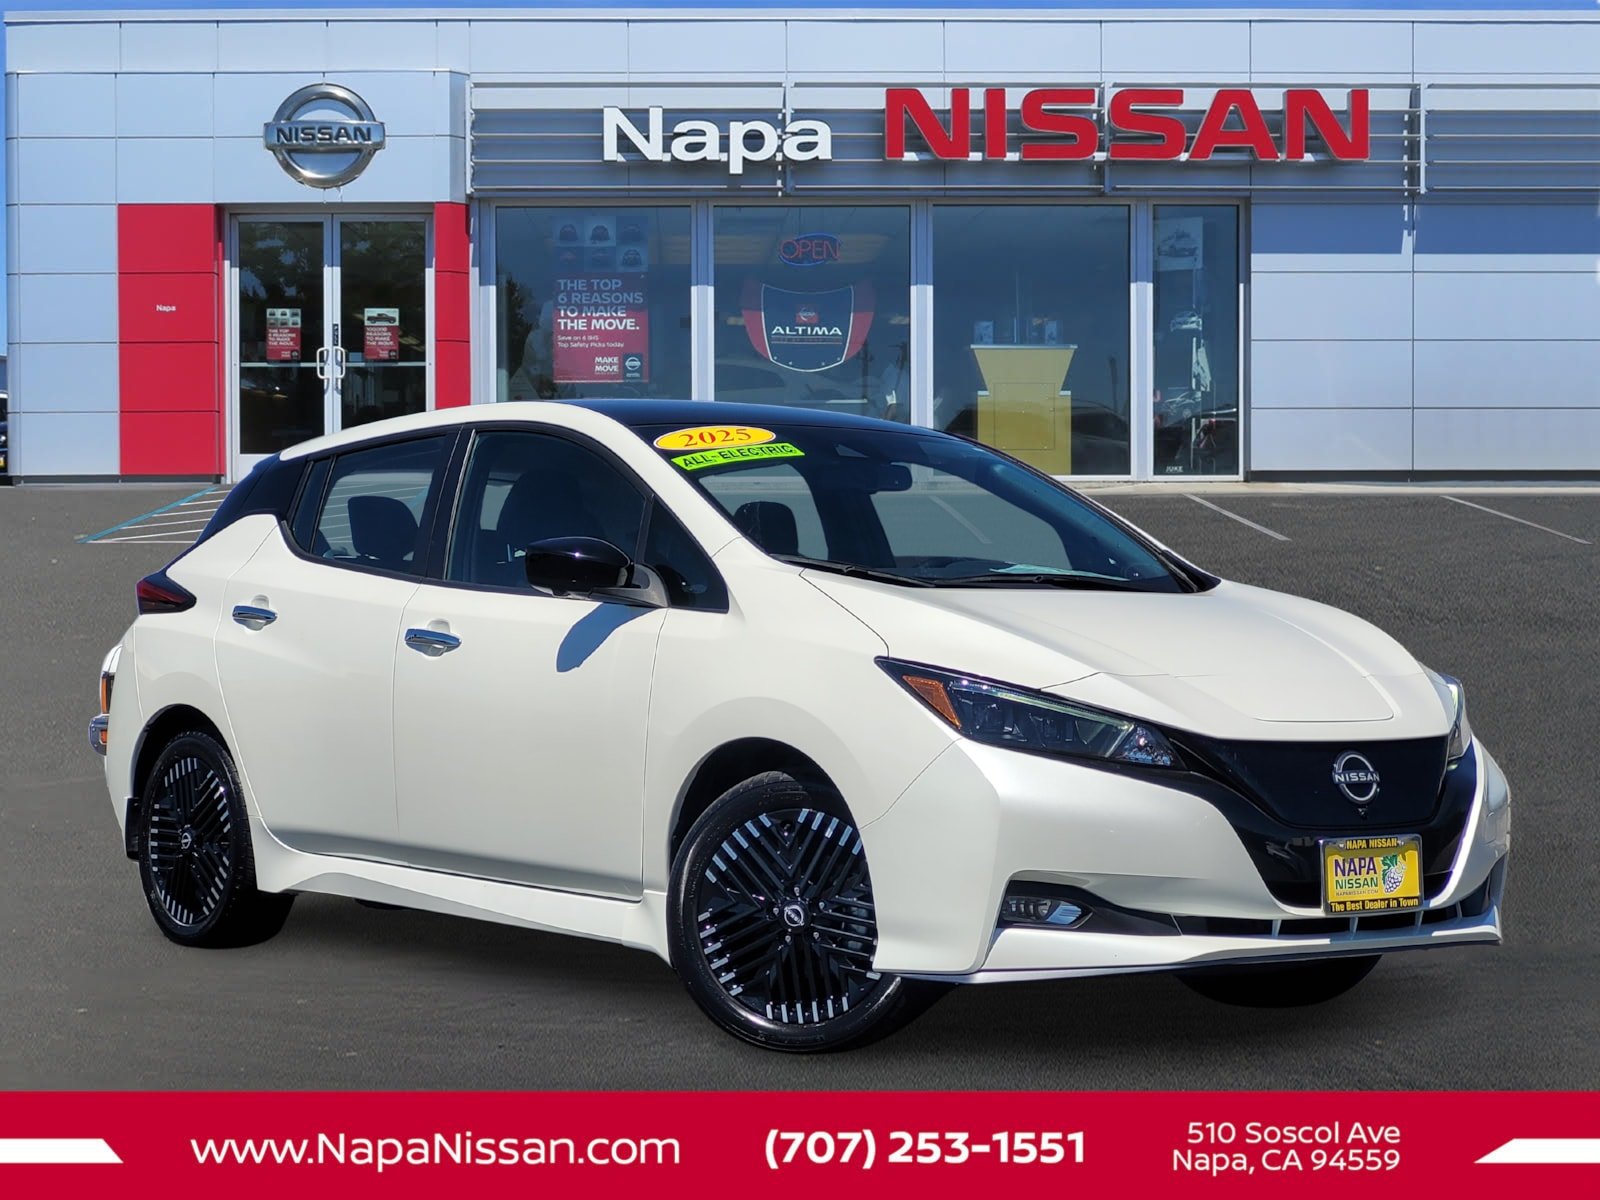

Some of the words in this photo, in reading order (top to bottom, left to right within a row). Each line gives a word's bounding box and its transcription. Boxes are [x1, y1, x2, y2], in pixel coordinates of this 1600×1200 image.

[276, 126, 372, 143] NISSAN
[603, 106, 833, 174] Napa
[885, 88, 1370, 161] NISSAN
[780, 239, 841, 259] OPEN
[557, 279, 587, 291] THE
[591, 279, 622, 291] TOP
[558, 292, 568, 304] 6
[571, 292, 644, 304] REASONS
[156, 304, 177, 312] Napa
[557, 306, 578, 317] TO
[582, 306, 627, 317] MAKE
[557, 319, 587, 330] THE
[591, 319, 640, 330] MOVE.
[771, 326, 843, 336] ALTIMA
[678, 428, 752, 447] 2025
[682, 444, 794, 467] ALL-ELECTRIC
[1334, 771, 1380, 783] NISSAN
[1346, 839, 1367, 850] NAPA
[1368, 837, 1398, 849] NISSAN
[1334, 857, 1377, 877] NAPA
[1335, 877, 1379, 890] NISSAN
[1330, 902, 1345, 913] The
[1346, 900, 1363, 911] Best
[1364, 899, 1388, 910] Dealer
[1389, 898, 1398, 908] in
[1399, 897, 1419, 907] Town
